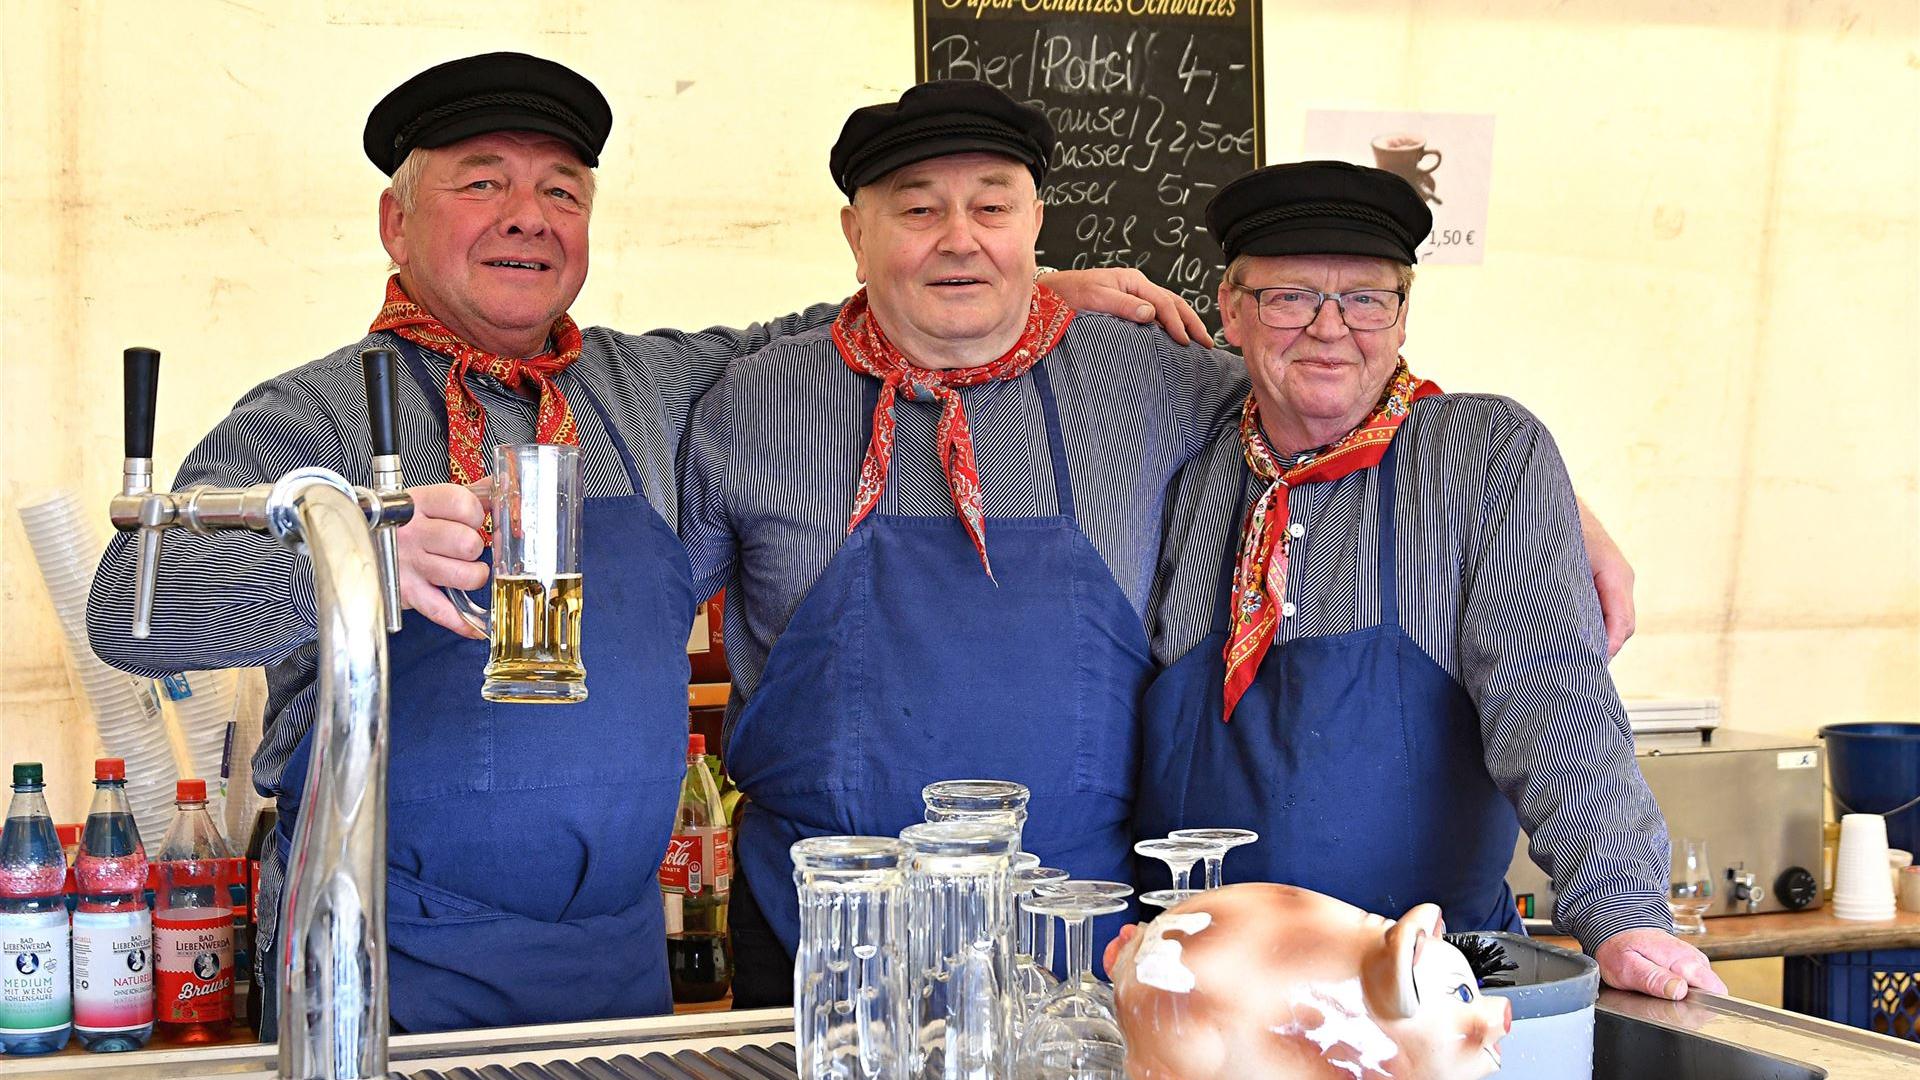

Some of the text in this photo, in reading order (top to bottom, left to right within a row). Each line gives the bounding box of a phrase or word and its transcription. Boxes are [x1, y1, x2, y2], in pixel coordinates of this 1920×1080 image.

[1466, 230, 1476, 245] €
[4, 977, 53, 988] MEDIUM
[178, 976, 231, 1000] Brause
[23, 986, 53, 995] WENIG
